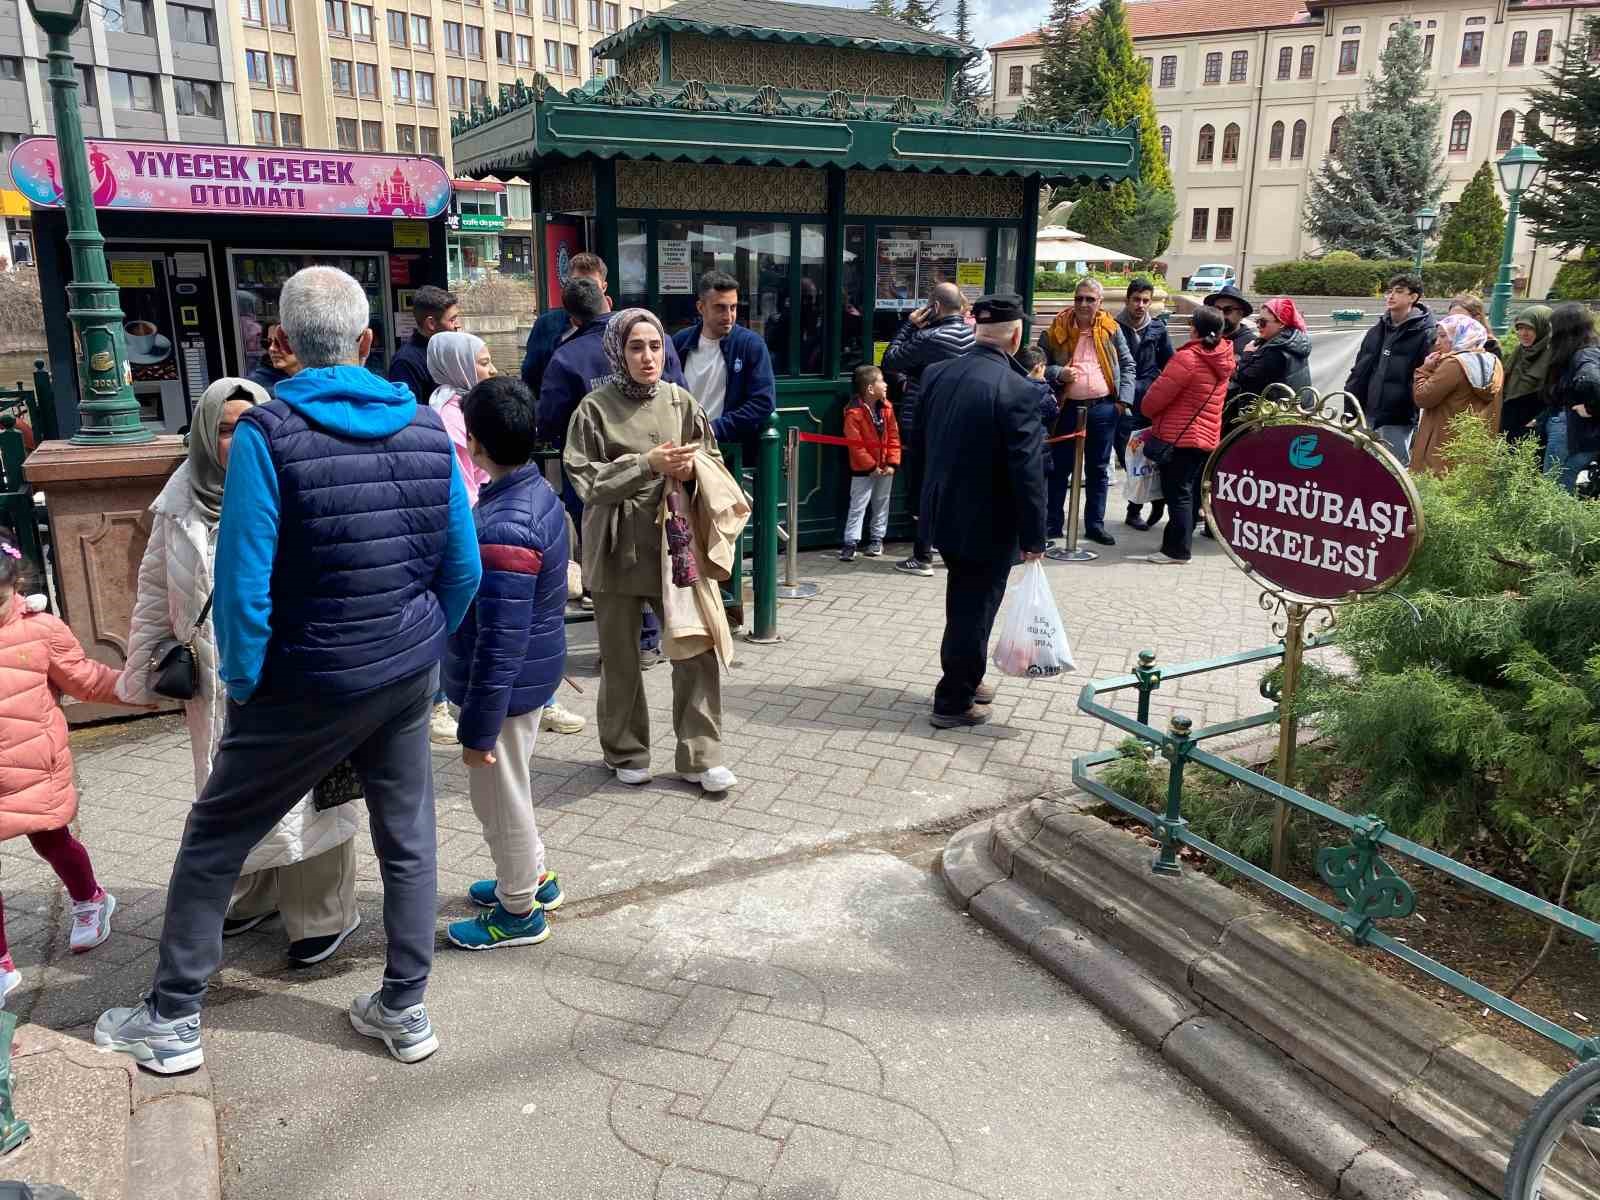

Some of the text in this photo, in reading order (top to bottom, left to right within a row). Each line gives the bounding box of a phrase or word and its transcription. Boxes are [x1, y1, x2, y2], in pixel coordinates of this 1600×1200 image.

[190, 184, 305, 209] OTOMATI
[1216, 468, 1408, 543] KÖPRÜBAŞI
[1231, 511, 1379, 582] İSKELESİ
